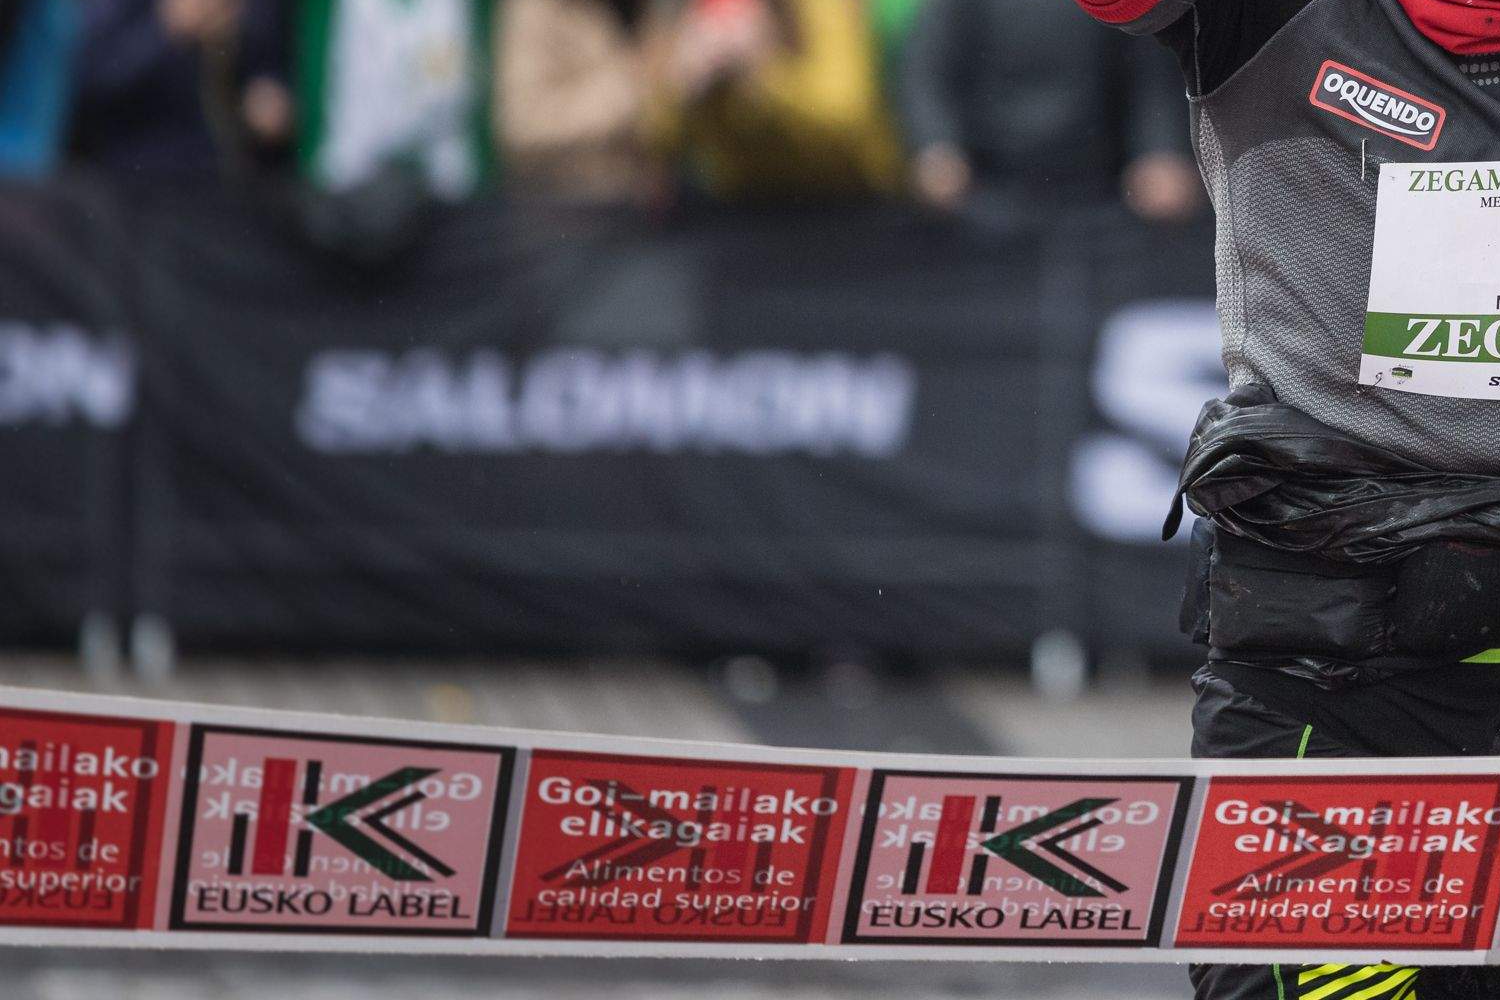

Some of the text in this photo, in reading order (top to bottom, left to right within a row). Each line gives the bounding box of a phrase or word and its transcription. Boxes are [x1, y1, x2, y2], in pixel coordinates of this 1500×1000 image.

[1323, 73, 1436, 135] OQUENDO
[538, 776, 838, 817] Goi-mailako
[560, 810, 806, 848] elikagaiak
[78, 837, 119, 862] de
[1234, 828, 1480, 860] elikagaiak
[0, 868, 140, 895] superior
[565, 859, 796, 887] Alimentos de
[1236, 873, 1465, 894] Alimentos de
[197, 886, 472, 920] EUSKO LABEL
[537, 886, 816, 916] calidad superior
[1208, 899, 1485, 924] calidad superior
[869, 905, 1142, 931] EUSKO LABEL
